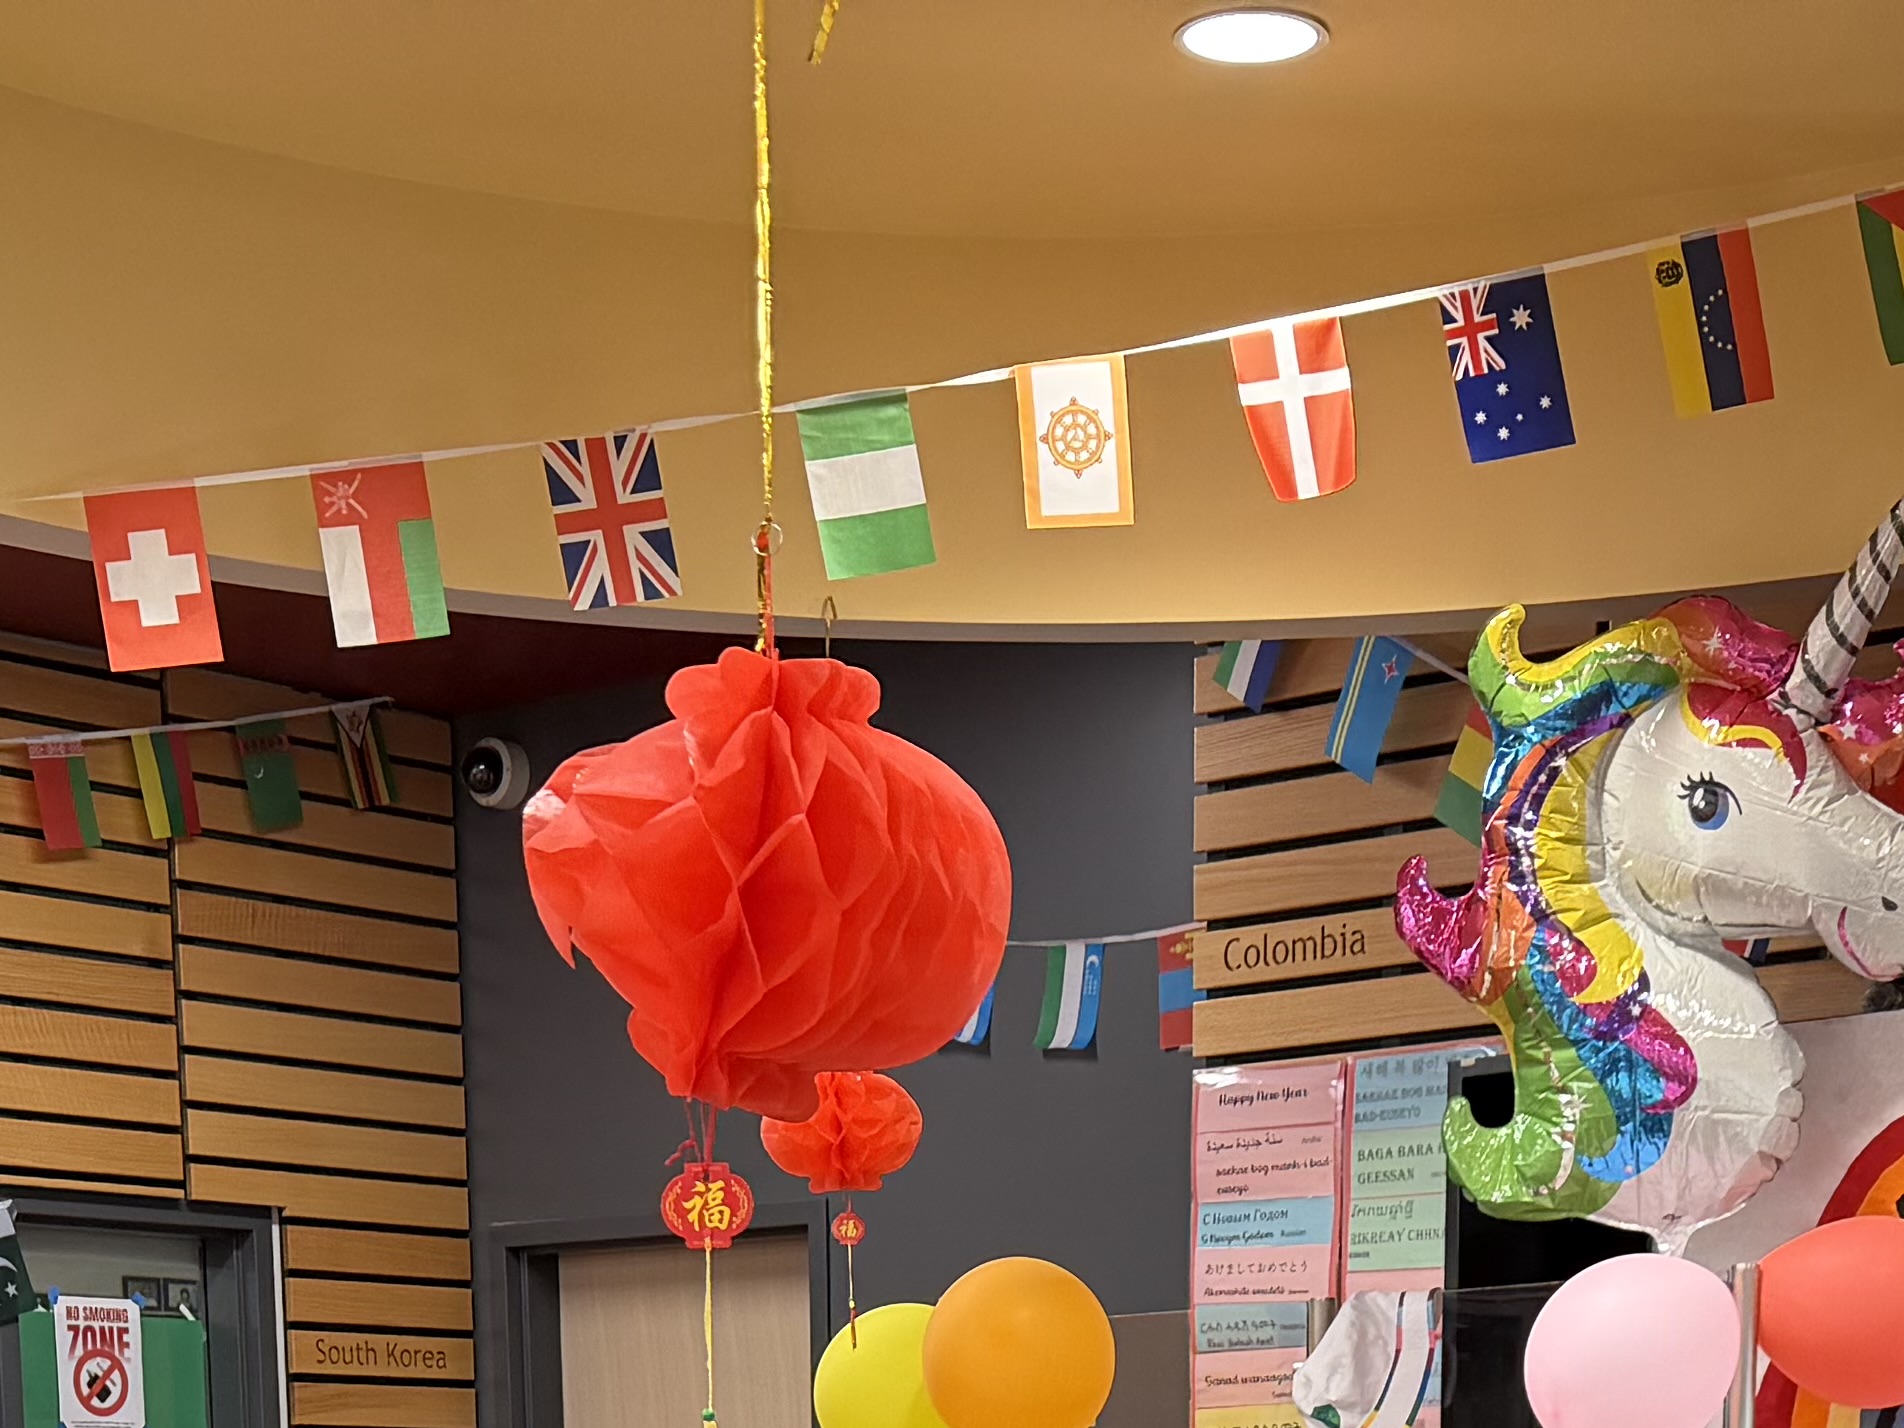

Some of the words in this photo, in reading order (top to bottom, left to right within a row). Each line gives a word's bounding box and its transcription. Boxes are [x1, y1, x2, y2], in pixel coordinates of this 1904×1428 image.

[1223, 922, 1366, 972] Colombia
[1218, 1093, 1254, 1107] Happy
[1257, 1090, 1279, 1103] New
[1282, 1086, 1309, 1103] Year
[681, 1179, 732, 1232] 福
[65, 1305, 80, 1321] NO
[82, 1305, 129, 1324] SMOKING
[66, 1323, 132, 1364] ZONE
[315, 1338, 378, 1367] South
[386, 1341, 448, 1370] Korea
